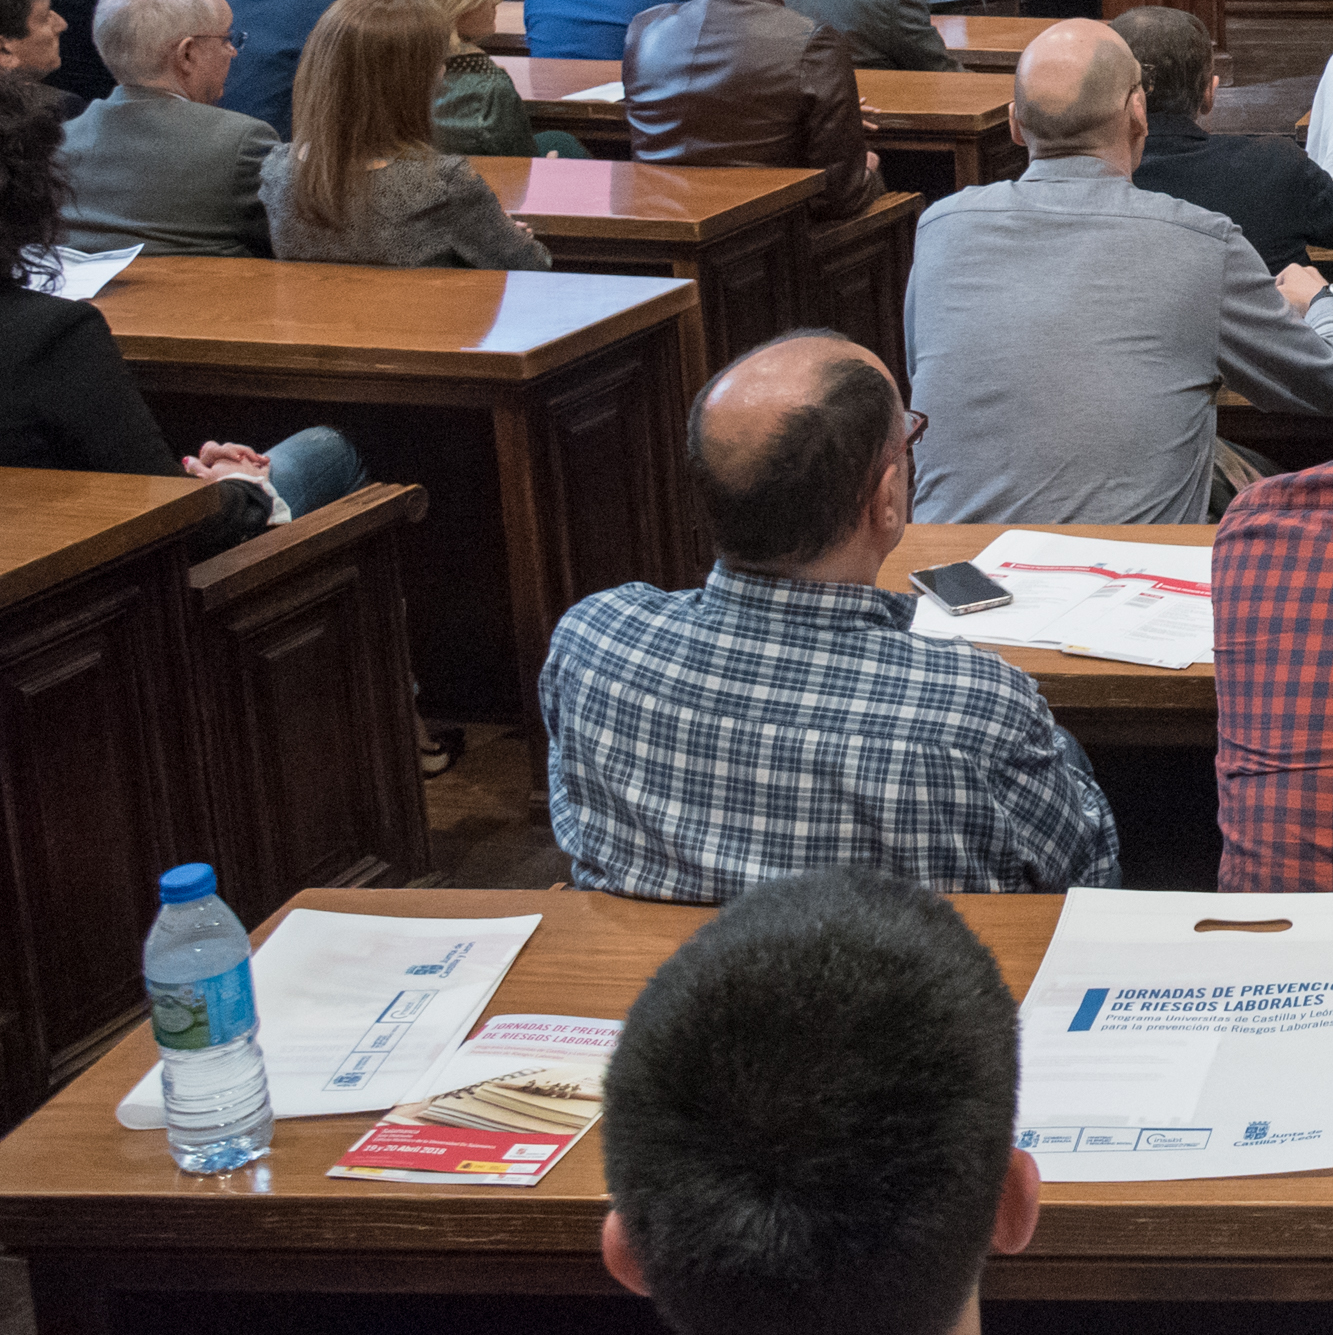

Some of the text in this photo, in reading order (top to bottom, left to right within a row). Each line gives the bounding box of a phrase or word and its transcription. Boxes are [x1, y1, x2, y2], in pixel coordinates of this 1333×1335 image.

[1115, 987, 1207, 1000] JORNADAS
[1211, 986, 1236, 998] DE
[1110, 994, 1326, 1012] DE RIESGOS LABORALES
[1105, 1014, 1162, 1024] Programa
[1165, 1015, 1231, 1023] Universitas
[1235, 1015, 1249, 1023] de
[1251, 1012, 1298, 1024] Castilla
[1299, 1013, 1307, 1021] y
[491, 1022, 552, 1032] JORNADAS
[552, 1024, 571, 1033] DE
[1100, 1024, 1128, 1032] para
[1132, 1023, 1143, 1031] la
[1146, 1023, 1210, 1032] prevención
[1214, 1023, 1227, 1032] de
[1230, 1024, 1277, 1035] Riesgos
[481, 1032, 497, 1040] DE
[499, 1033, 552, 1042] RIESGOS
[1233, 1139, 1277, 1147] Castilla
[1290, 1133, 1322, 1142] León
[1269, 1131, 1304, 1139] Junta
[396, 1145, 421, 1153] Abril
